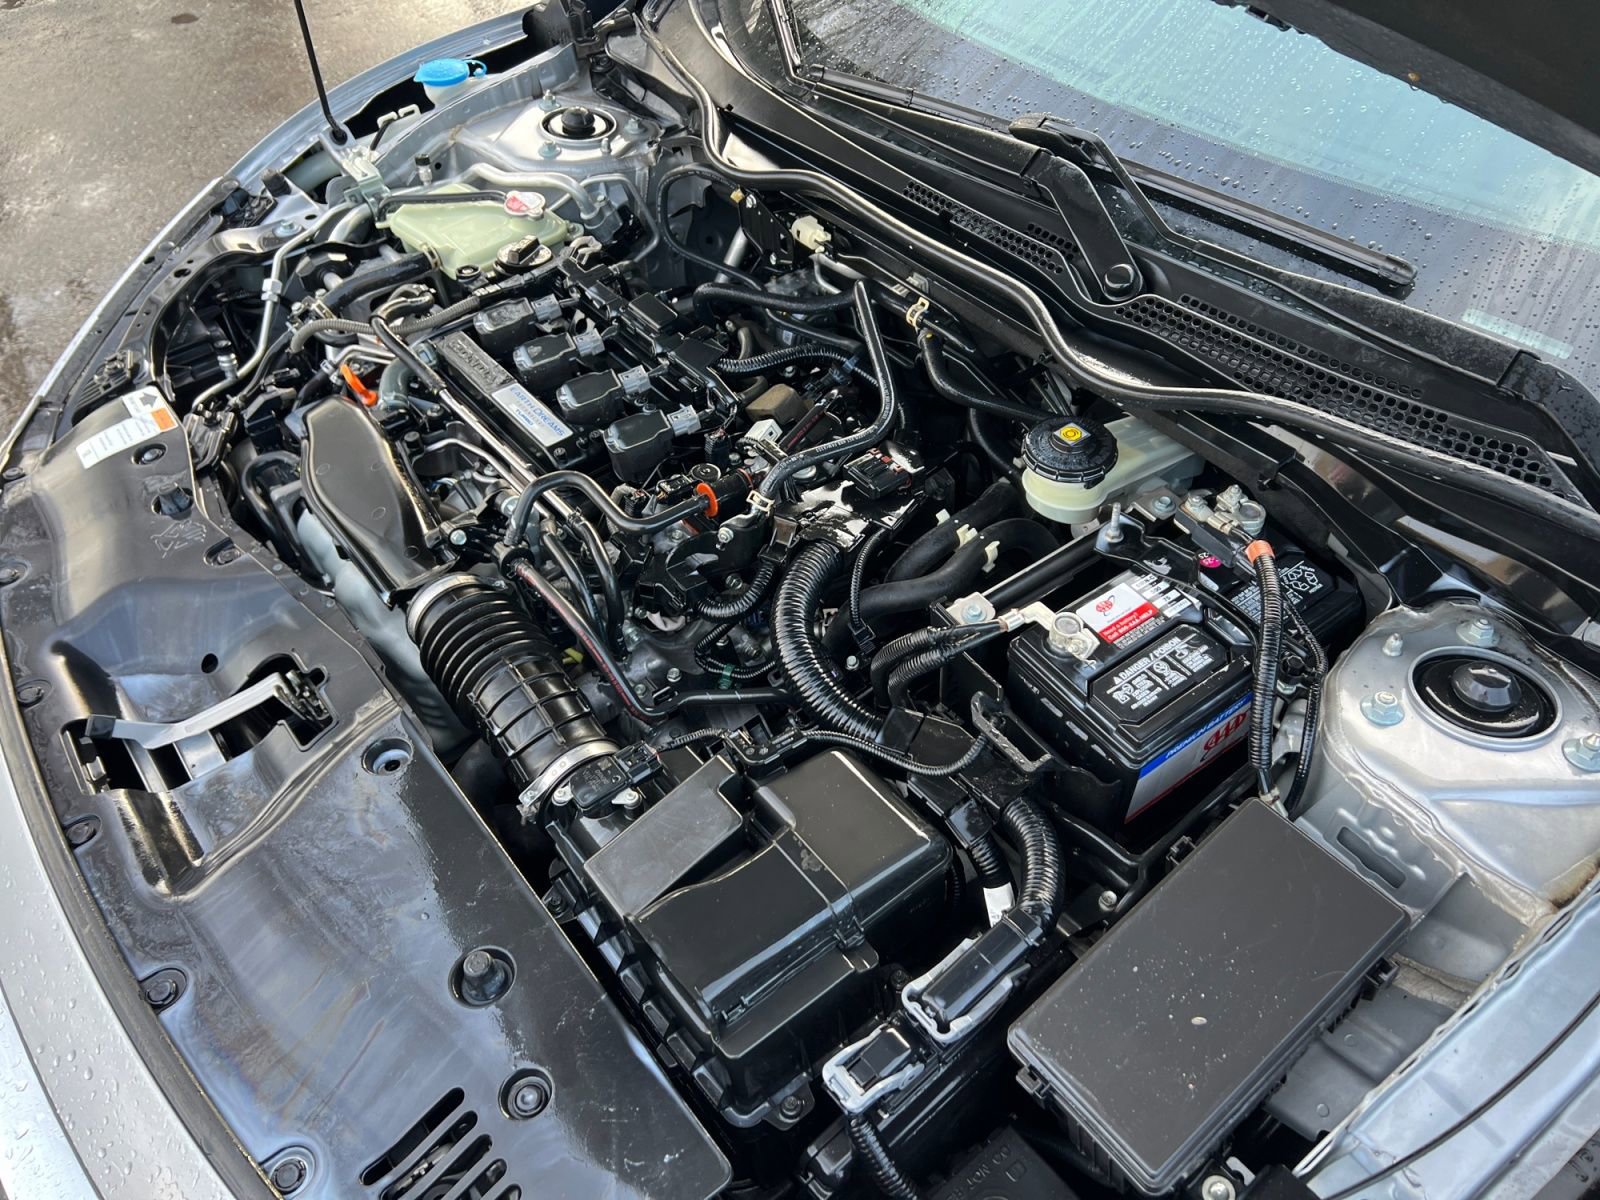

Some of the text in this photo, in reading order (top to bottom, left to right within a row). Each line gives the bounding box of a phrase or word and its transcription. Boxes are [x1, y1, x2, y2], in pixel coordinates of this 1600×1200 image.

[510, 387, 565, 436] EARTH DREAMS
[515, 408, 534, 426] TURBO
[1119, 657, 1152, 679] DANGER
[1153, 636, 1182, 657] POISON
[1204, 712, 1247, 750] AAA
[967, 1164, 991, 1189] NOT
